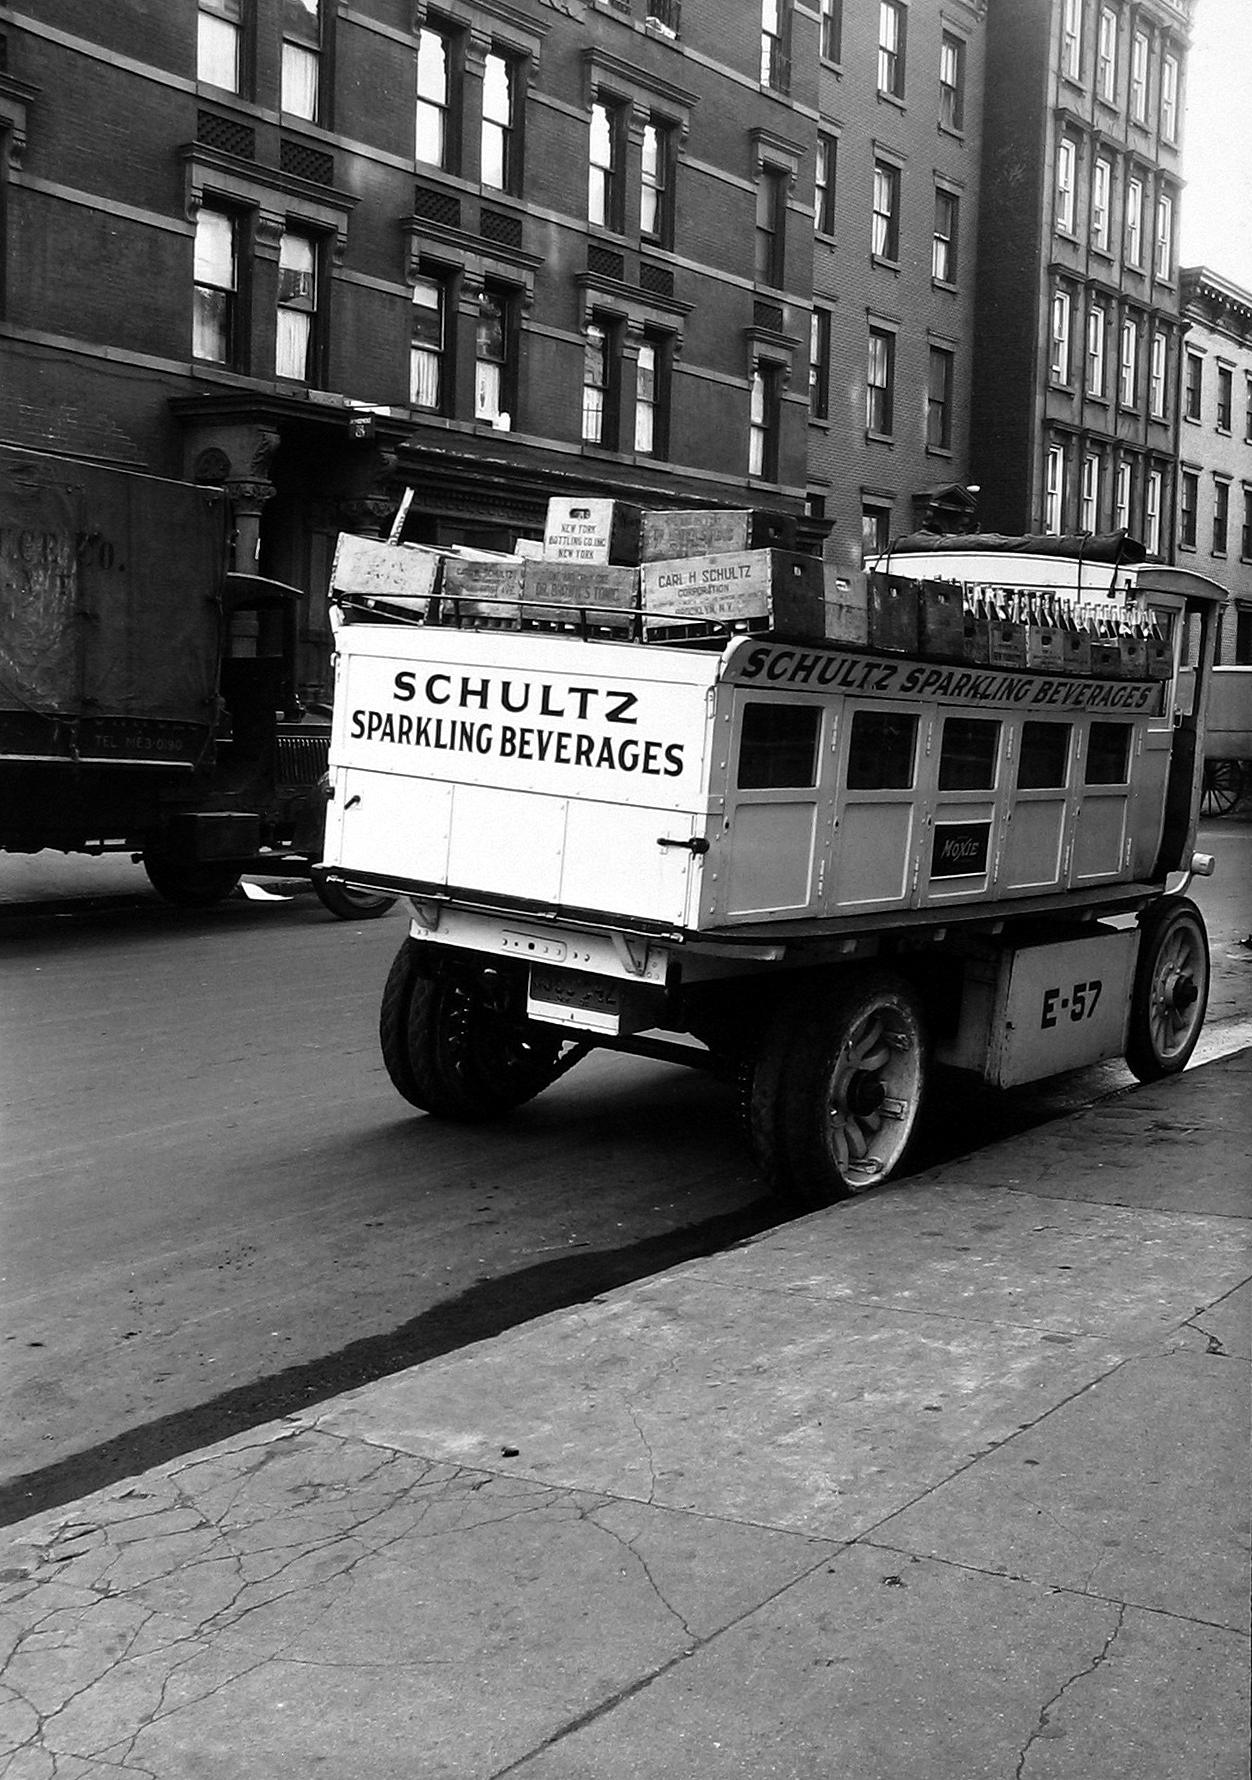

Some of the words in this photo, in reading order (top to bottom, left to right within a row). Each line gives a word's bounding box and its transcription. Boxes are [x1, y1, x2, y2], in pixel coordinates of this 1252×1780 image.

[561, 523, 576, 533] NEW
[578, 524, 597, 534] YORK
[548, 535, 582, 546] BOTTLING
[558, 549, 573, 558] NEW
[576, 550, 594, 559] YORK
[658, 573, 683, 588] CARL
[689, 571, 697, 583] H
[702, 565, 751, 583] SCHULTZ
[740, 647, 885, 691] SCHULTZ
[898, 664, 1031, 705] SPARKLING
[1030, 680, 1153, 709] BEVERAGES
[394, 671, 638, 725] SCHULTZ
[350, 709, 493, 755] SPARKLING
[500, 725, 684, 777] BEVERAGES
